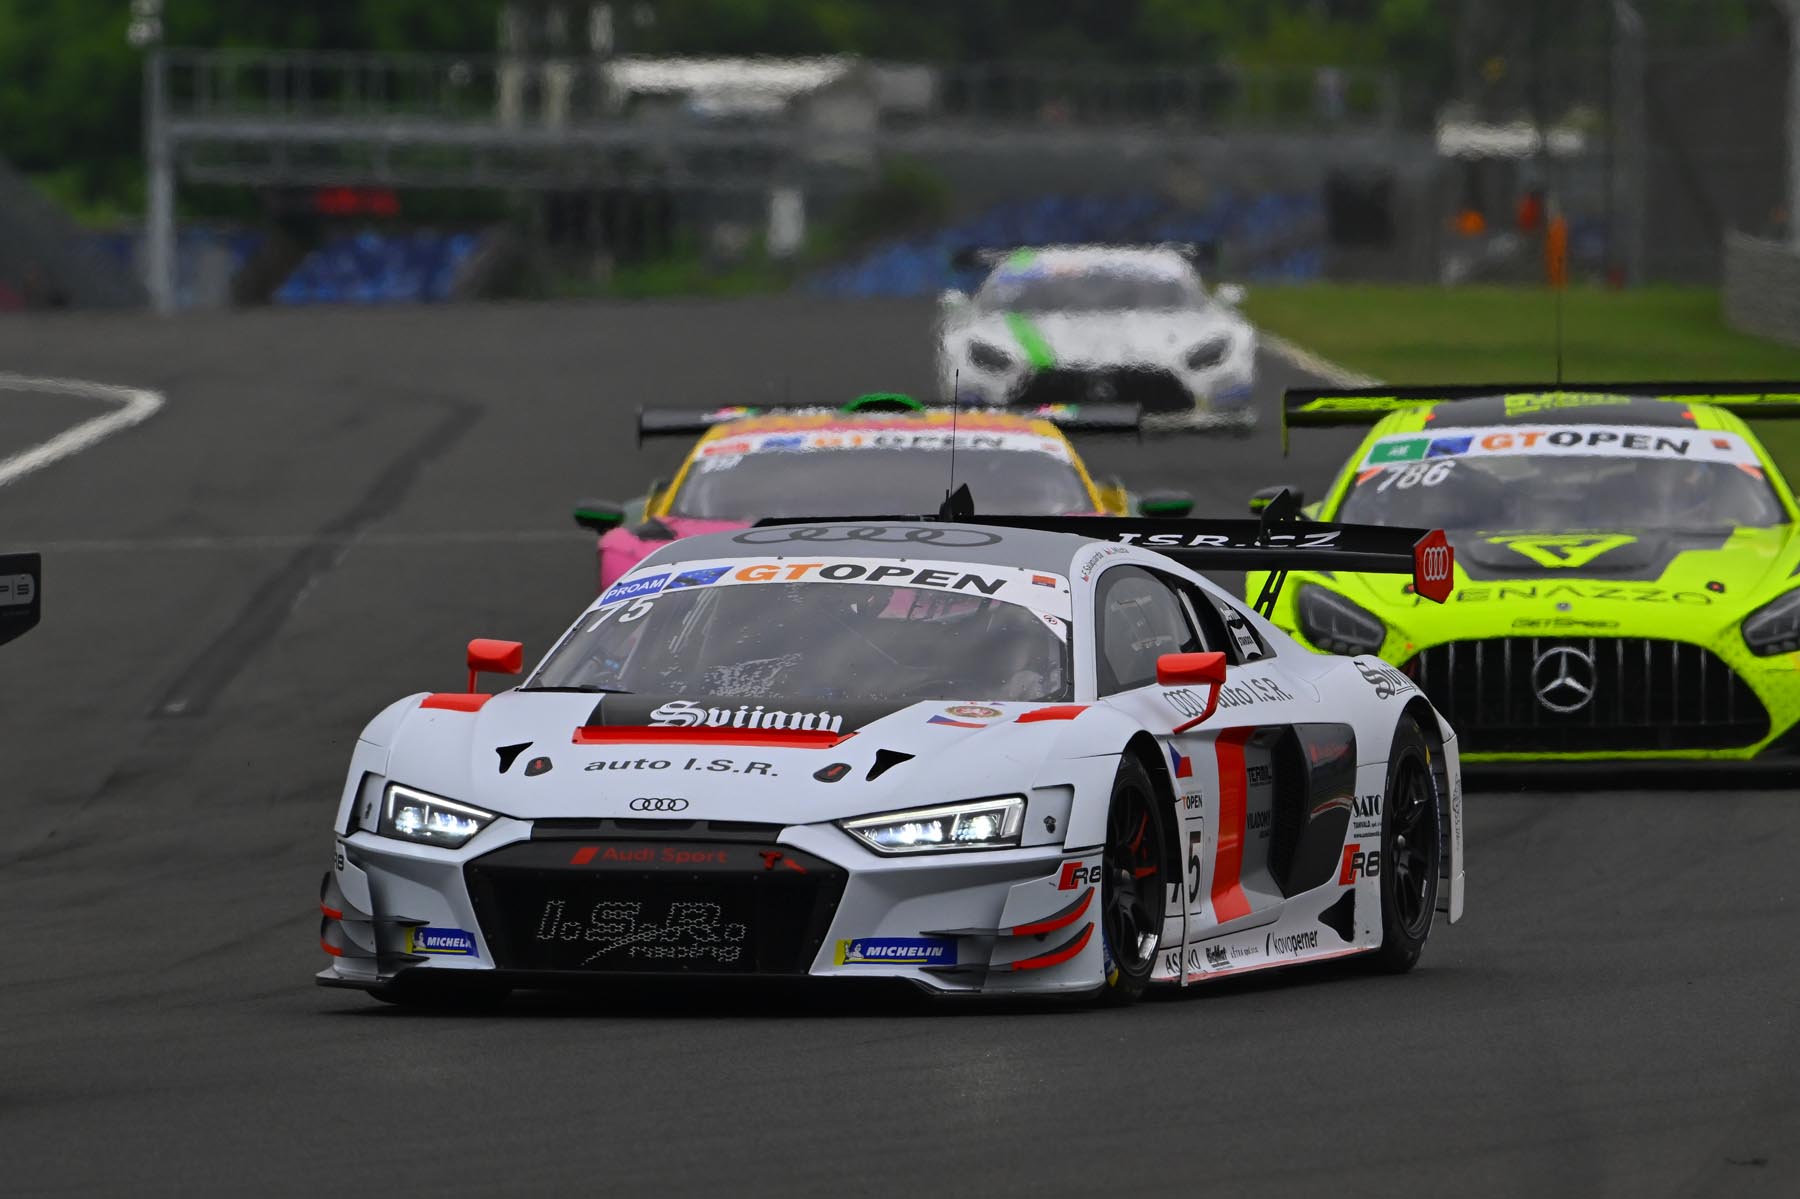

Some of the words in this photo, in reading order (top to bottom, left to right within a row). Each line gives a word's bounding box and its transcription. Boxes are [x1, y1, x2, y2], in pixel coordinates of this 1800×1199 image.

[1377, 459, 1457, 494] 786
[607, 577, 664, 601] PROAM
[587, 593, 664, 633] 75
[648, 700, 843, 734] Svijany
[584, 758, 671, 772] auto
[683, 757, 778, 777] I.S.R.
[602, 848, 655, 862] Audi
[660, 848, 728, 864] Sport
[1348, 850, 1380, 881] R8
[1071, 865, 1101, 886] R8
[866, 946, 943, 957] MICHELIN
